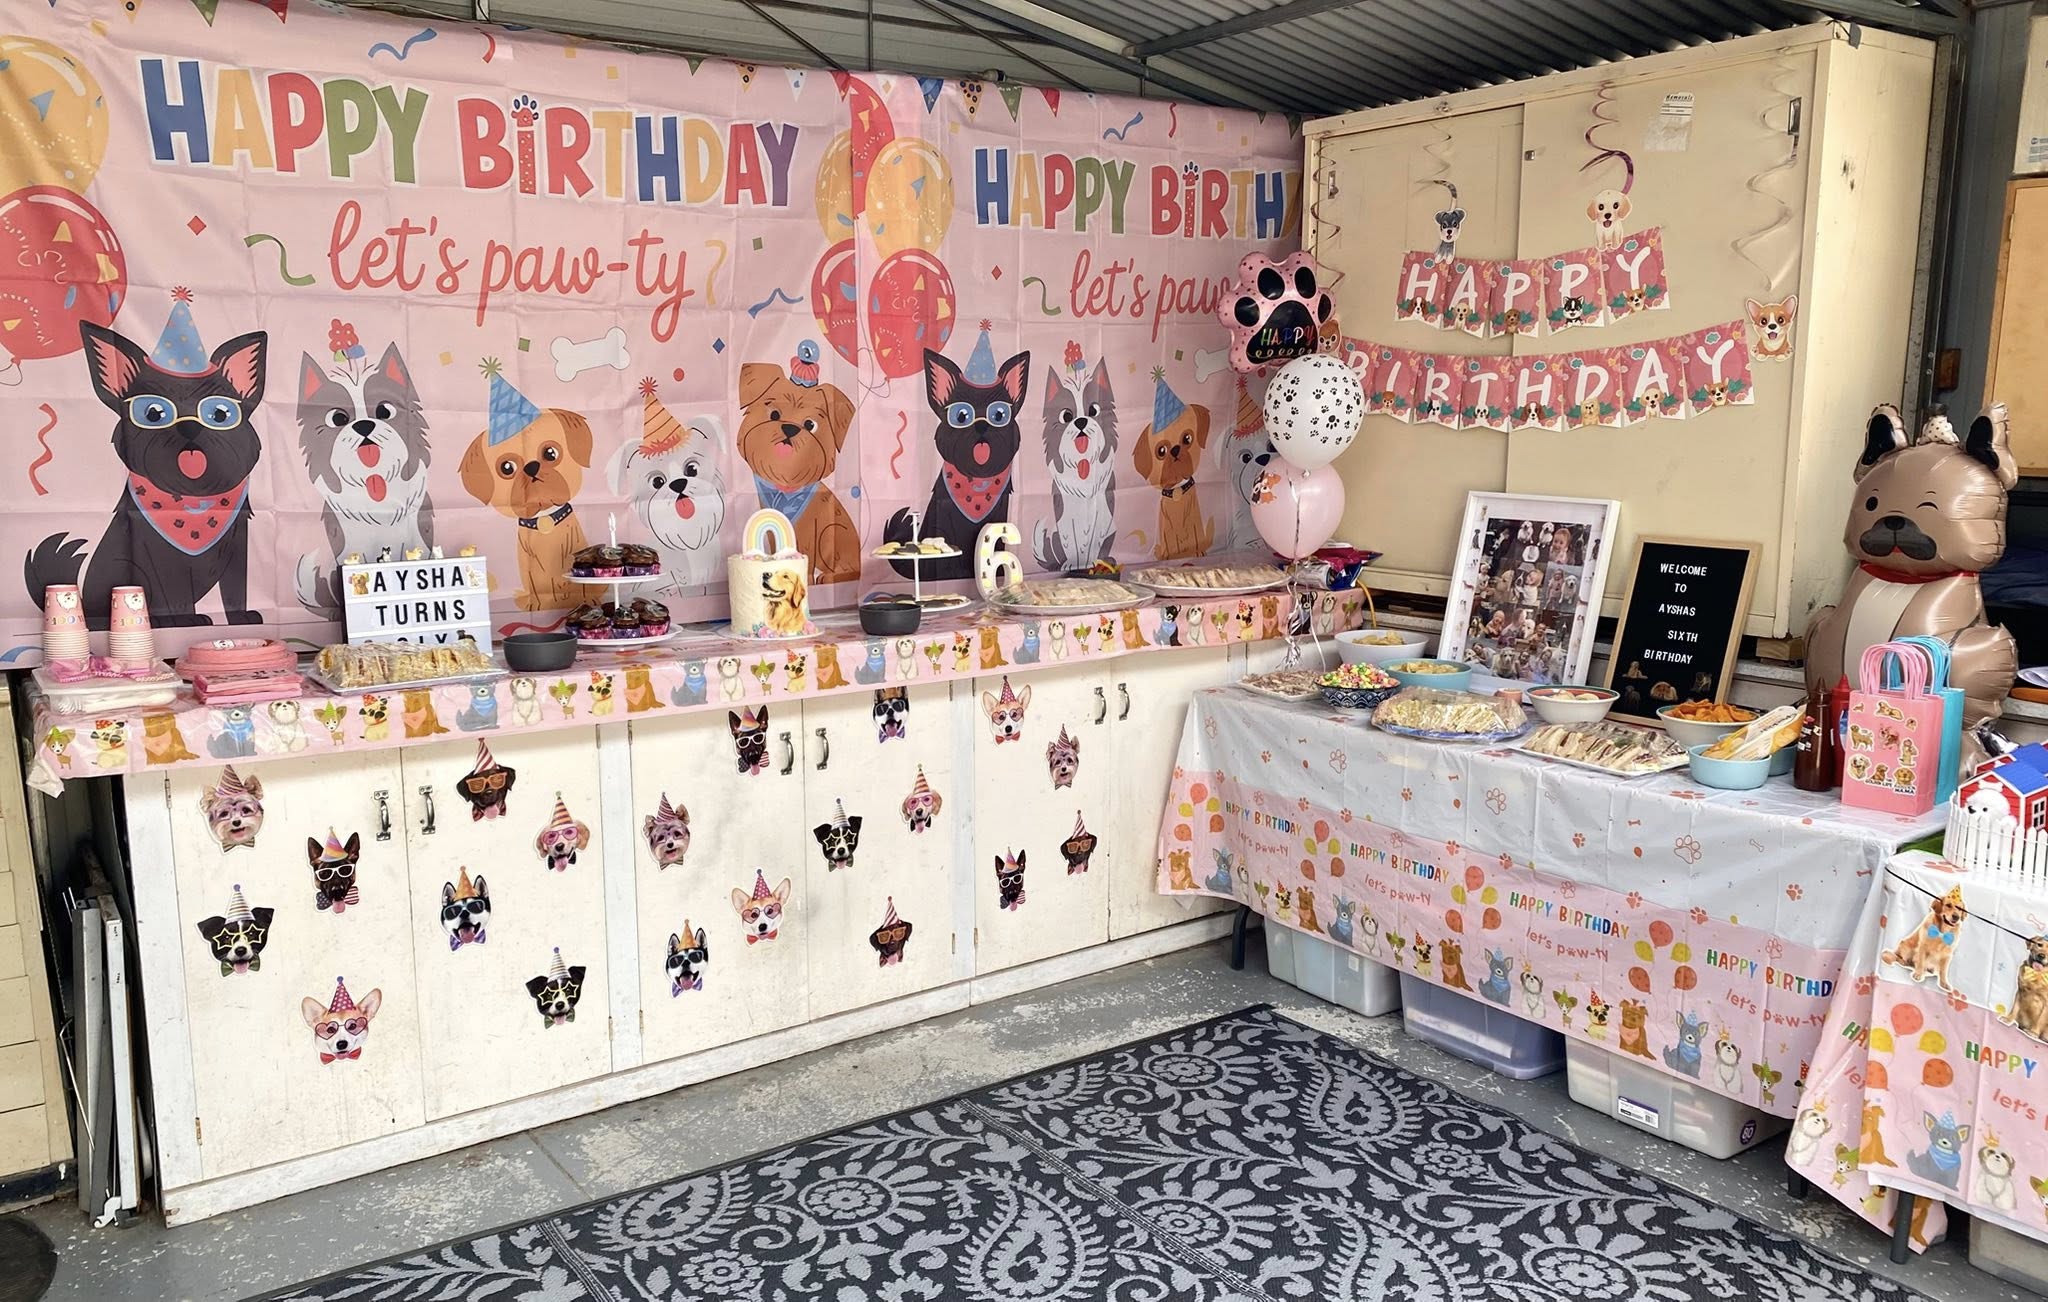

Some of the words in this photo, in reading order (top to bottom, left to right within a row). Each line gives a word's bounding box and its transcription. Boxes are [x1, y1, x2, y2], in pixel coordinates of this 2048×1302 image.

[140, 58, 429, 184] HAPPY
[975, 148, 1136, 234] HAPPY
[328, 200, 467, 292] let's
[477, 230, 695, 343] paw-ty
[1070, 249, 1150, 318] let's
[1406, 247, 1650, 313] HAPPY
[1260, 325, 1315, 346] HAPPY
[1345, 339, 1735, 406] BIRTHDAY
[373, 566, 464, 592] AYSHA
[1660, 563, 1707, 576] WELCOME
[1674, 583, 1687, 593] TO
[375, 599, 466, 626] TURNS
[1658, 603, 1696, 617] AYSHAS
[1667, 630, 1698, 643] SIXTH
[1644, 649, 1693, 664] BIRTHDAY
[1254, 811, 1302, 836] BIRTHDAY
[1350, 843, 1386, 865] HAPPY
[1391, 854, 1450, 884] BIRTHDAY
[1364, 873, 1386, 894] let's
[1509, 891, 1553, 917] HAPPY
[1559, 905, 1629, 939] BIRTHDAY
[1526, 926, 1552, 949] let's
[1706, 949, 1758, 979] HAPPY
[1726, 988, 1757, 1015] let's
[1966, 1040, 2038, 1079] HAPPY
[1993, 1088, 2037, 1121] let's
